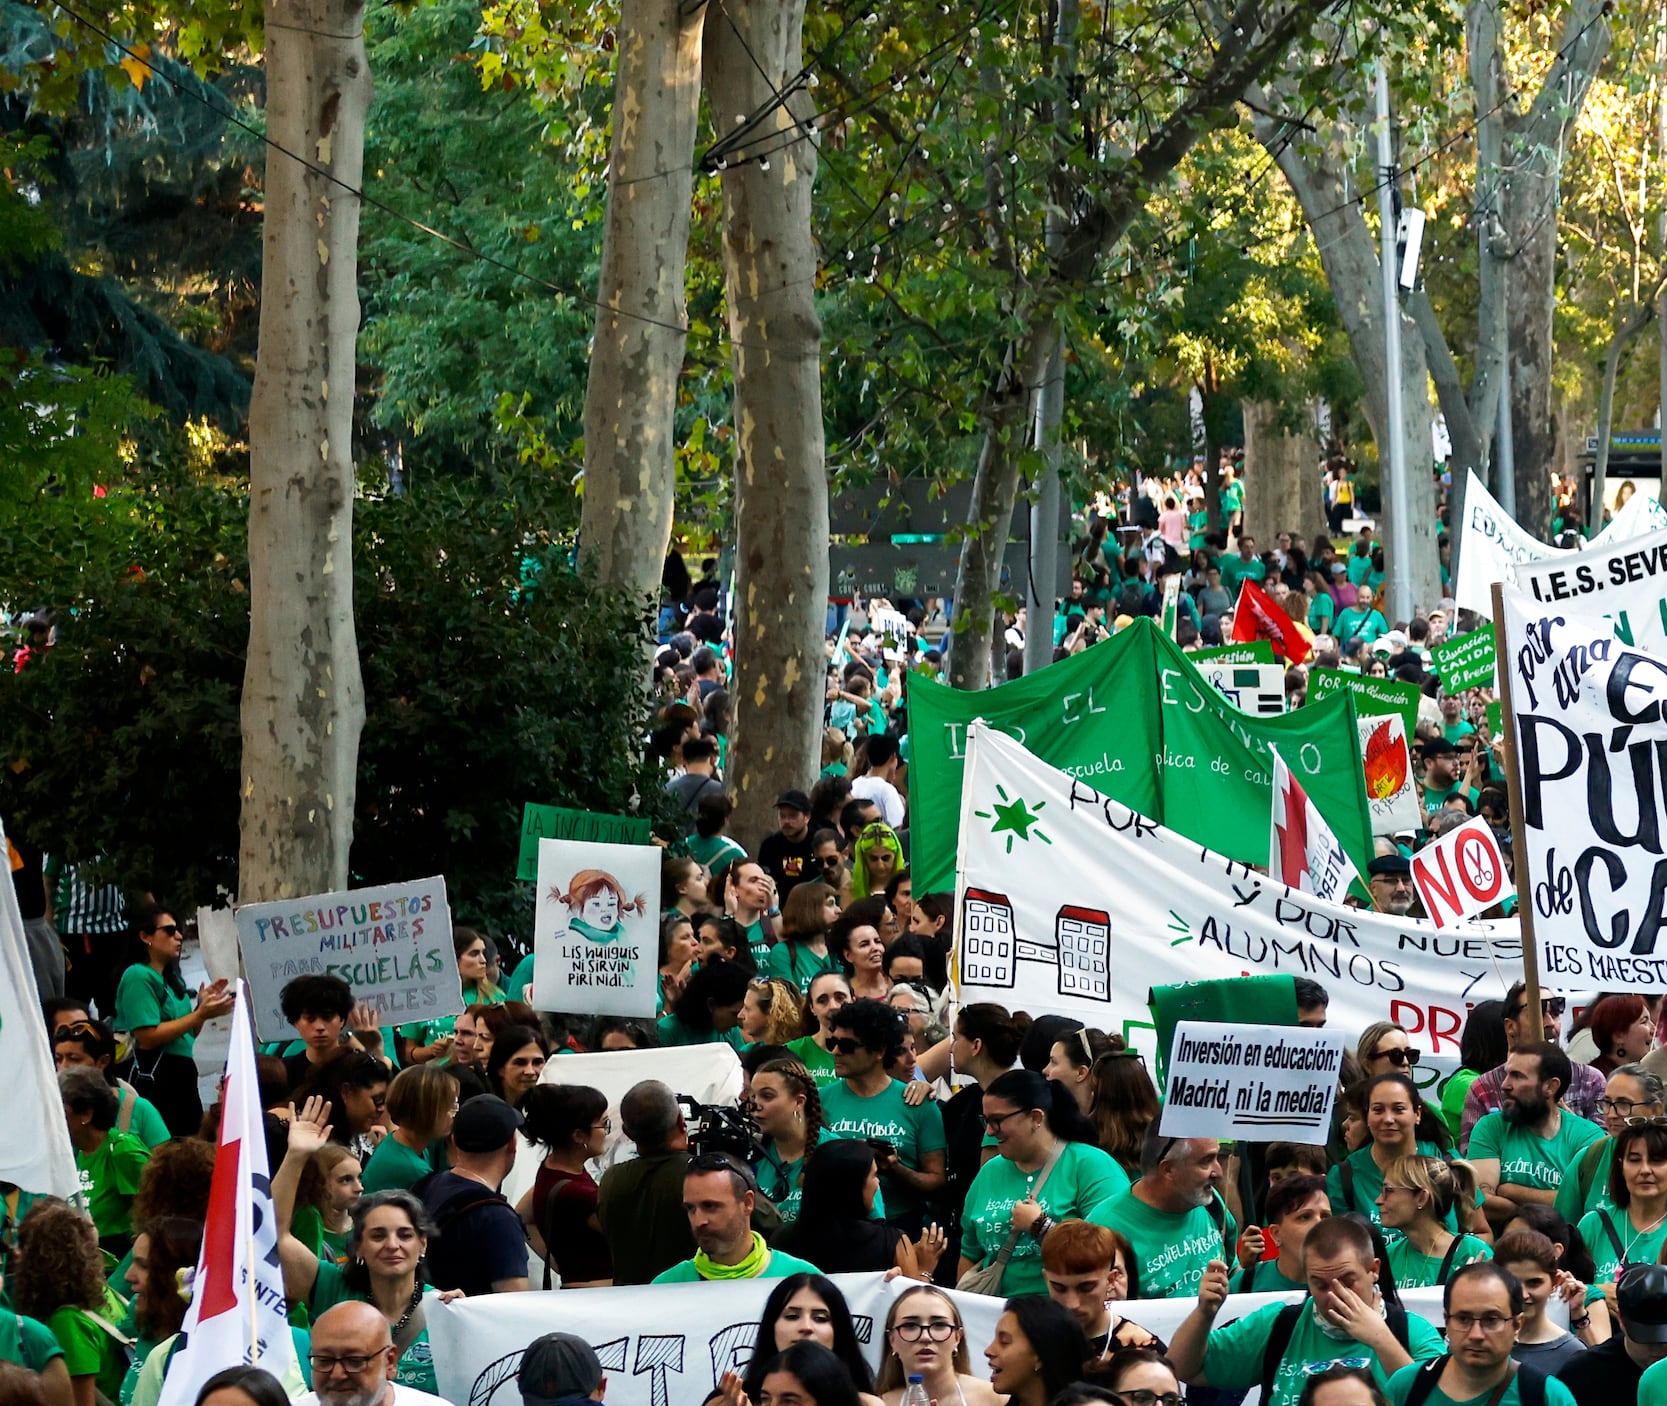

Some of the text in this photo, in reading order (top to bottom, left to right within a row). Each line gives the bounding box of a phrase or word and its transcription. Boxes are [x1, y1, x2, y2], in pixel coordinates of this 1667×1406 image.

[1530, 565, 1604, 604] I.E.S.
[1517, 615, 1566, 712] por
[1552, 635, 1612, 710] una
[1069, 779, 1163, 841] POR
[1411, 827, 1502, 930] NO
[254, 893, 432, 943] PRESUPUESTOS
[319, 918, 425, 952] MILITARES
[1199, 915, 1486, 999] ALUMNOS Y
[1177, 1032, 1339, 1072] Inversión en educación:
[1169, 1076, 1328, 1122] Madrid, ni la media!
